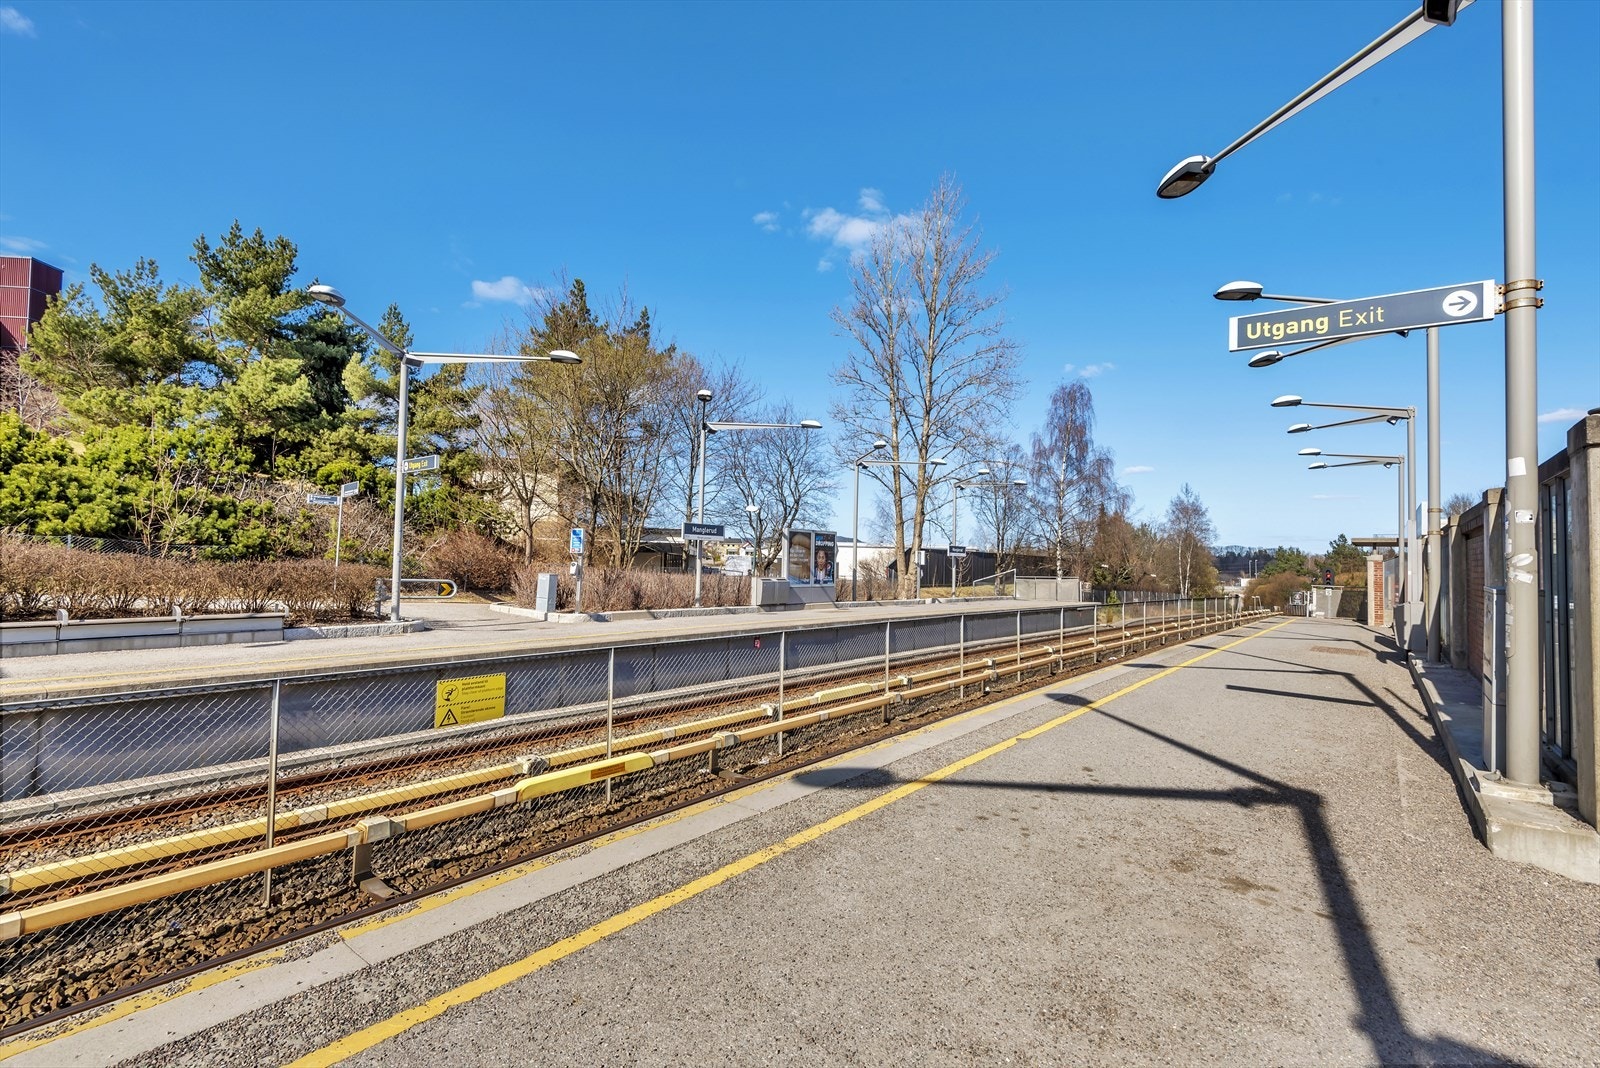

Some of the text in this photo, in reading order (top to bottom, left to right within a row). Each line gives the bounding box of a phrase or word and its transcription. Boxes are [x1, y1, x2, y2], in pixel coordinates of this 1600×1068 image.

[1246, 306, 1385, 340] Utgang Exit
[692, 525, 717, 534] Manglerud
